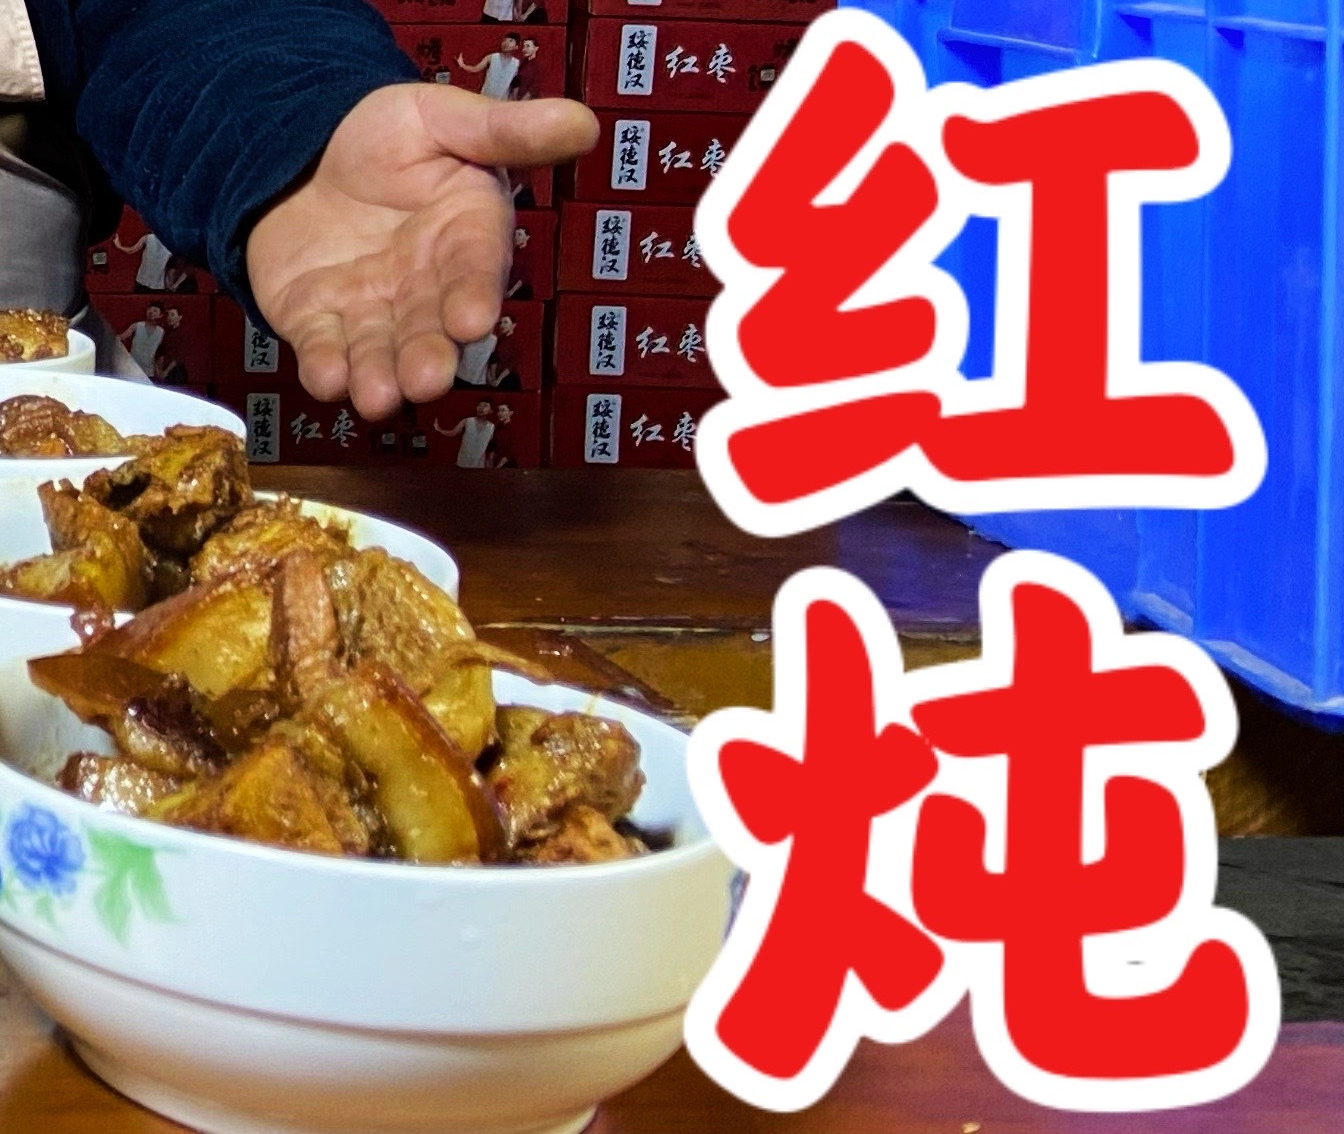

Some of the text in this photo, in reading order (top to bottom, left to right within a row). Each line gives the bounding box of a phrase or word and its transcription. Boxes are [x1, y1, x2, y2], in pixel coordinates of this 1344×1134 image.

[665, 43, 737, 84] 红枣
[658, 138, 726, 177] 红枣
[635, 323, 706, 363] 红枣
[290, 408, 358, 448] 红枣
[629, 411, 699, 451] 红枣
